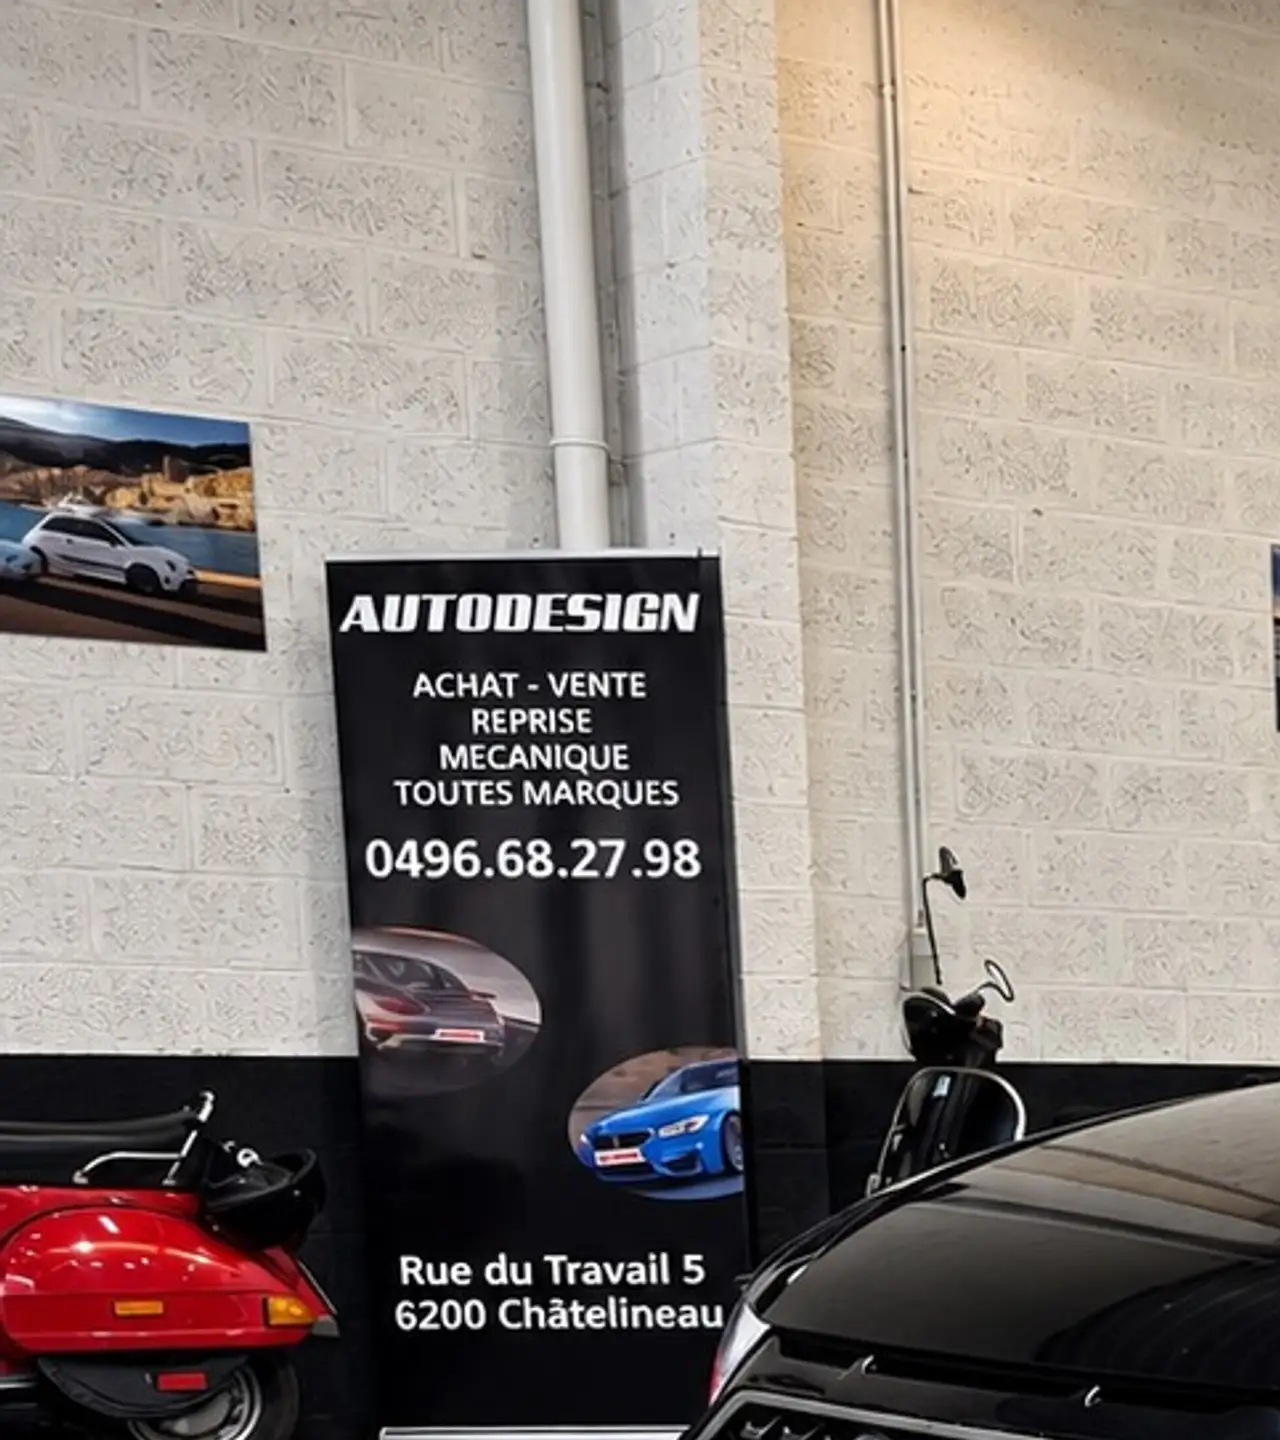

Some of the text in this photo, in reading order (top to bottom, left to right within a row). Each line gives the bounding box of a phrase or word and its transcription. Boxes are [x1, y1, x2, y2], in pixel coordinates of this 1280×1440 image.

[339, 592, 700, 633] AUTODESIGN
[413, 671, 520, 699] ACHAT
[547, 671, 647, 698] VENTE
[471, 708, 592, 735] REPRISE
[439, 743, 630, 776] MECANIQUE
[393, 779, 680, 811] TOUTES MARQUES
[364, 838, 702, 880] 0496.68.27.98
[400, 1251, 705, 1286] Rue du Travail 5
[395, 1295, 724, 1331] 6200 Châtelineau
